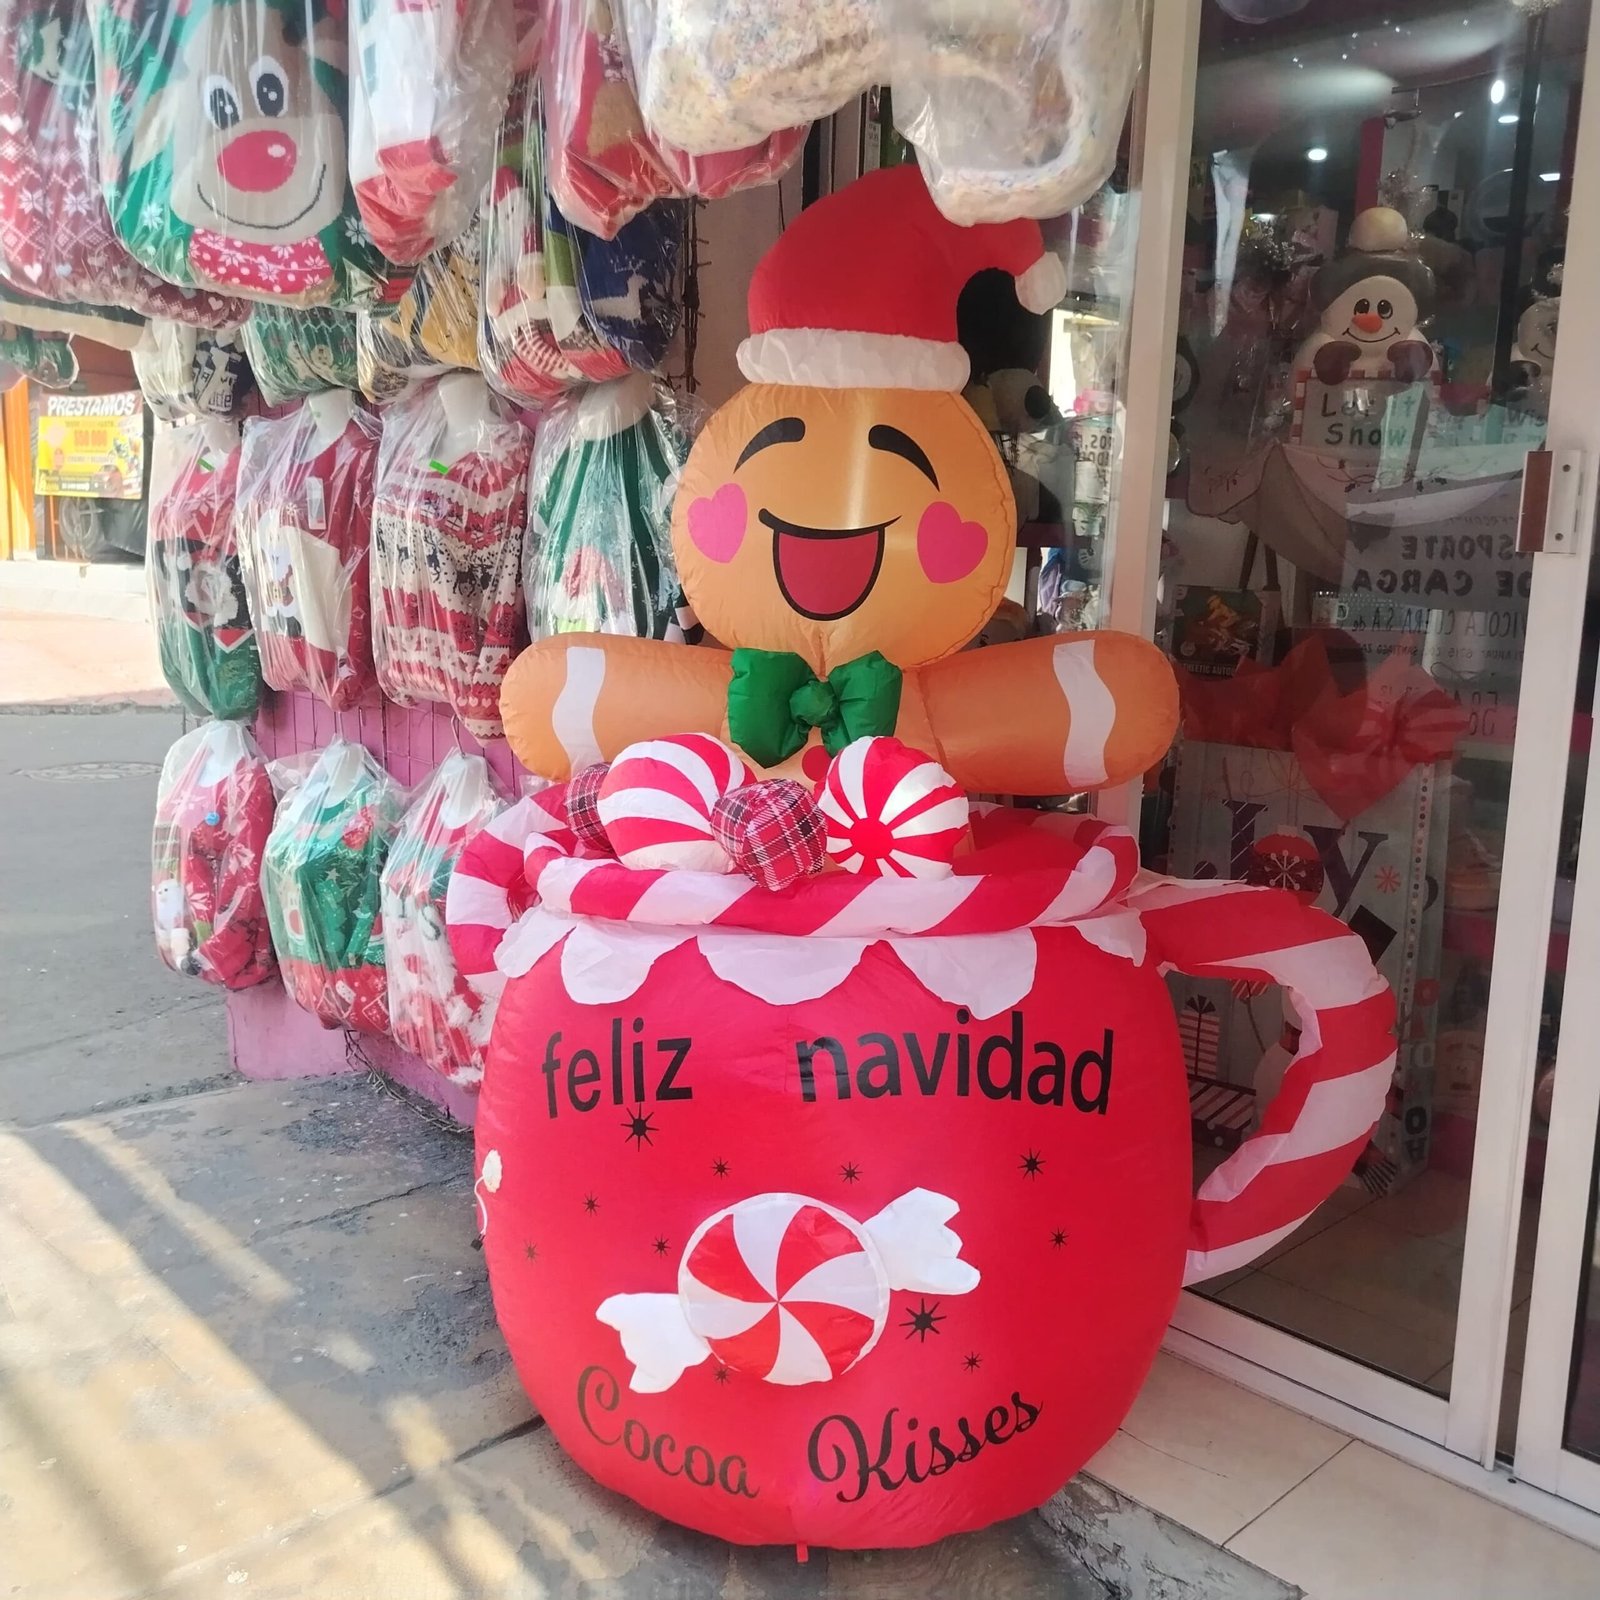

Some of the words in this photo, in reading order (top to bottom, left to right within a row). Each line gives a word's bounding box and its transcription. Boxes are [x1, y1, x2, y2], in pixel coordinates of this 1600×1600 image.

[47, 393, 136, 417] PRESTAMOS
[1324, 422, 1407, 446] Snow
[541, 1017, 693, 1119] feliz
[796, 1009, 1114, 1115] navidad
[577, 1365, 760, 1498] Cocoa
[808, 1391, 1043, 1503] Kisses
